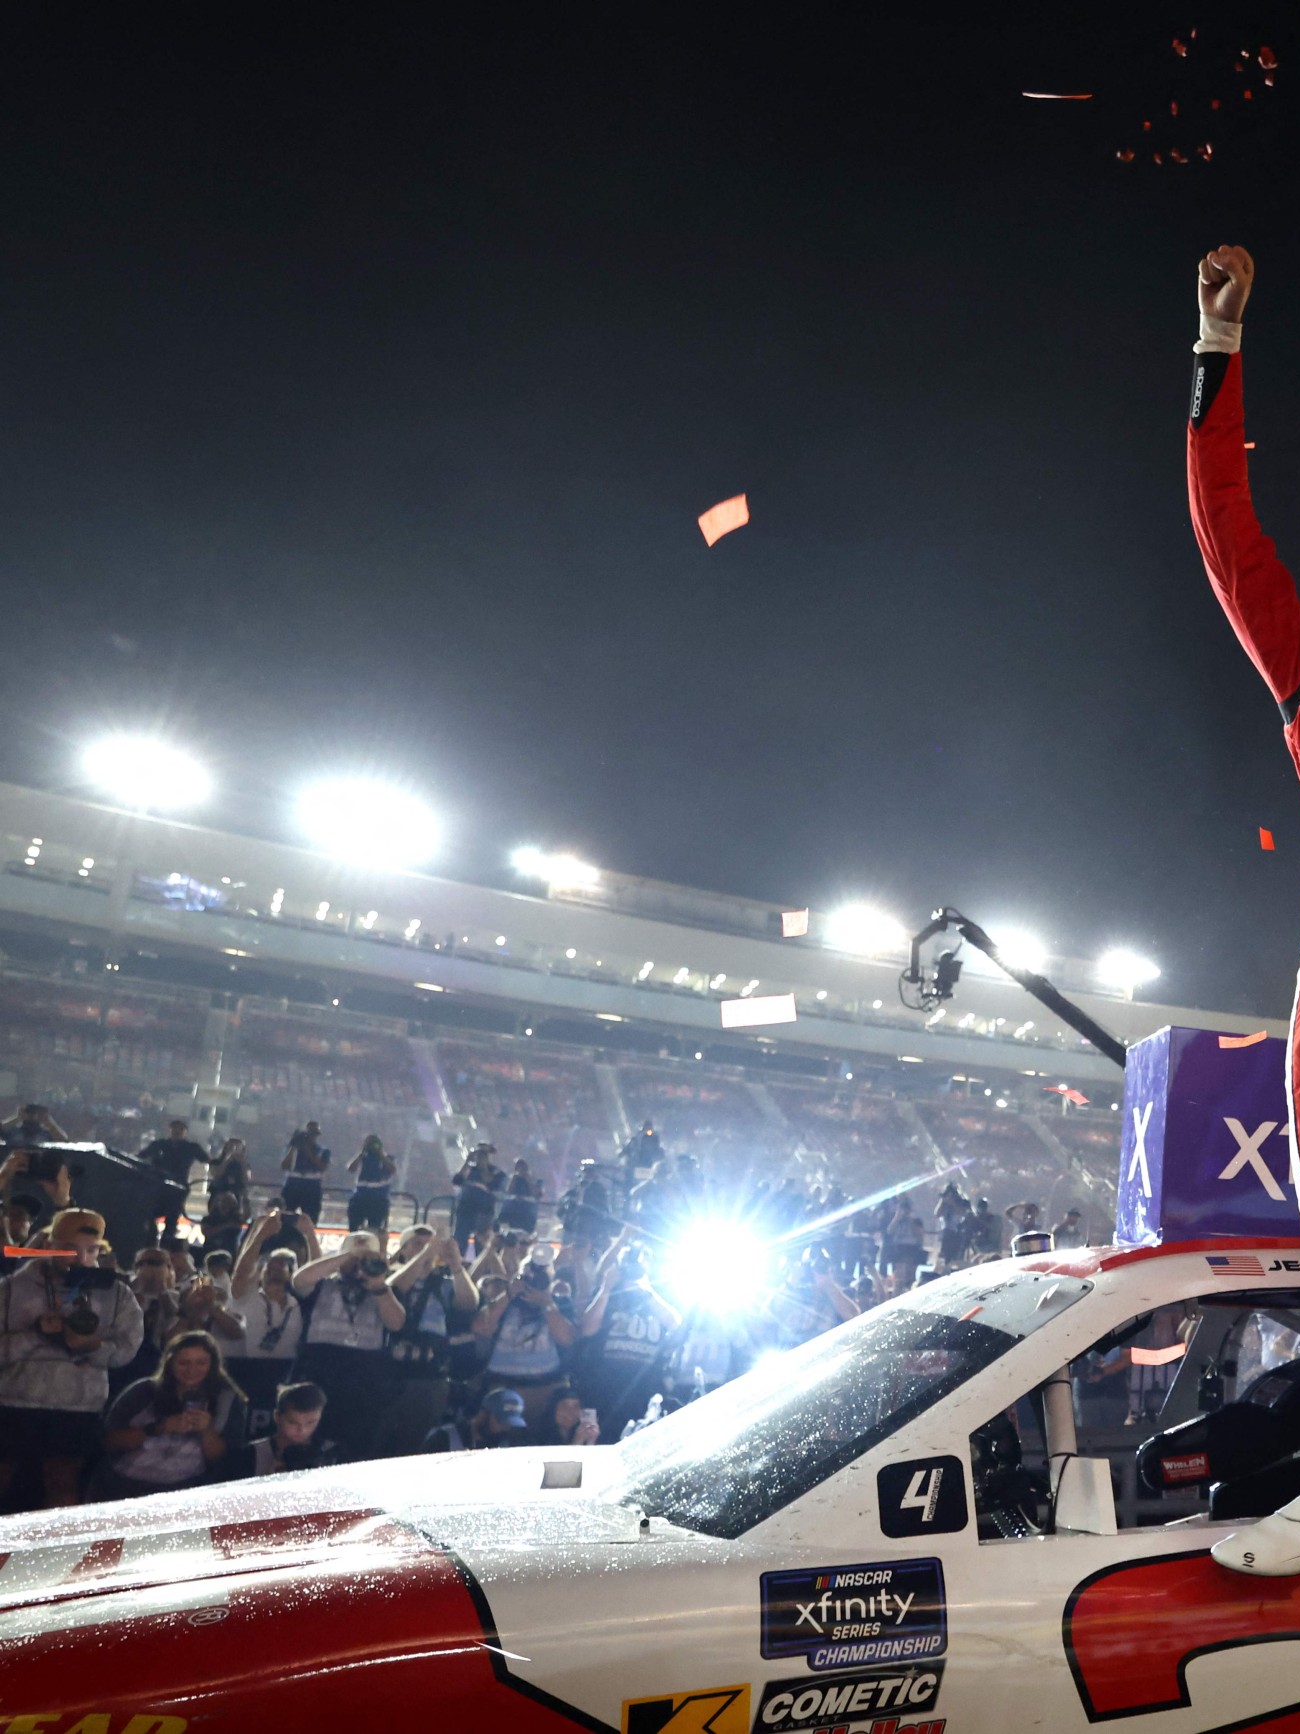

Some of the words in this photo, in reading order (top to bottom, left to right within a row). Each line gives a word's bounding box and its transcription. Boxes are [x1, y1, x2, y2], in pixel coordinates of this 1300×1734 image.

[1163, 1456, 1205, 1470] WHELEN
[900, 1467, 944, 1522] 4
[835, 1570, 893, 1588] NASCAR
[795, 1588, 915, 1634] xfinity
[832, 1622, 881, 1640] SERIES
[814, 1636, 942, 1666] CHAMPIONSHIP
[762, 1673, 937, 1724] COMETIC
[773, 1714, 841, 1731] GASKET
